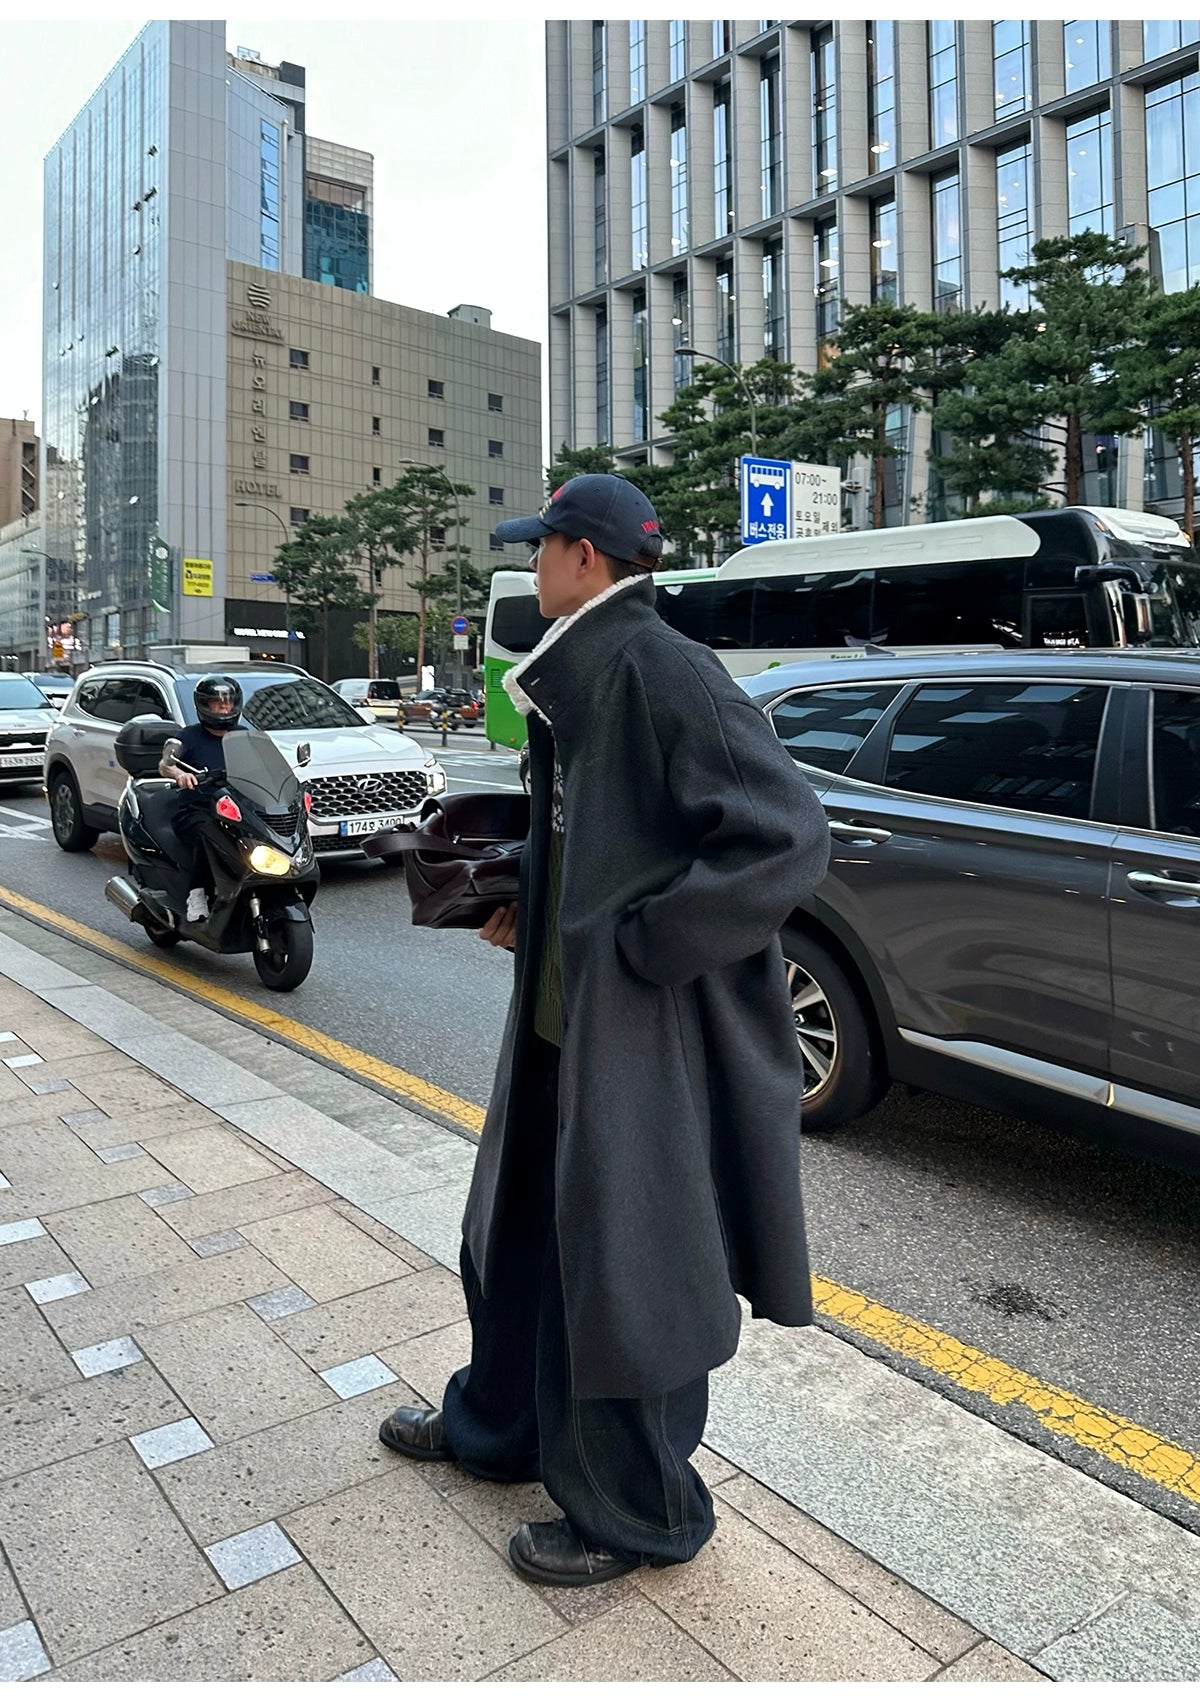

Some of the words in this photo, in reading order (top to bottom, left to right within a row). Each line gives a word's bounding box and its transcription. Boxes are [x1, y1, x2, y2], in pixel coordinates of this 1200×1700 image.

[246, 310, 271, 326] NEW
[234, 479, 283, 499] HOTEL
[812, 491, 838, 506] 21:00
[795, 510, 820, 524] 토요일
[749, 521, 785, 540] 버스전용
